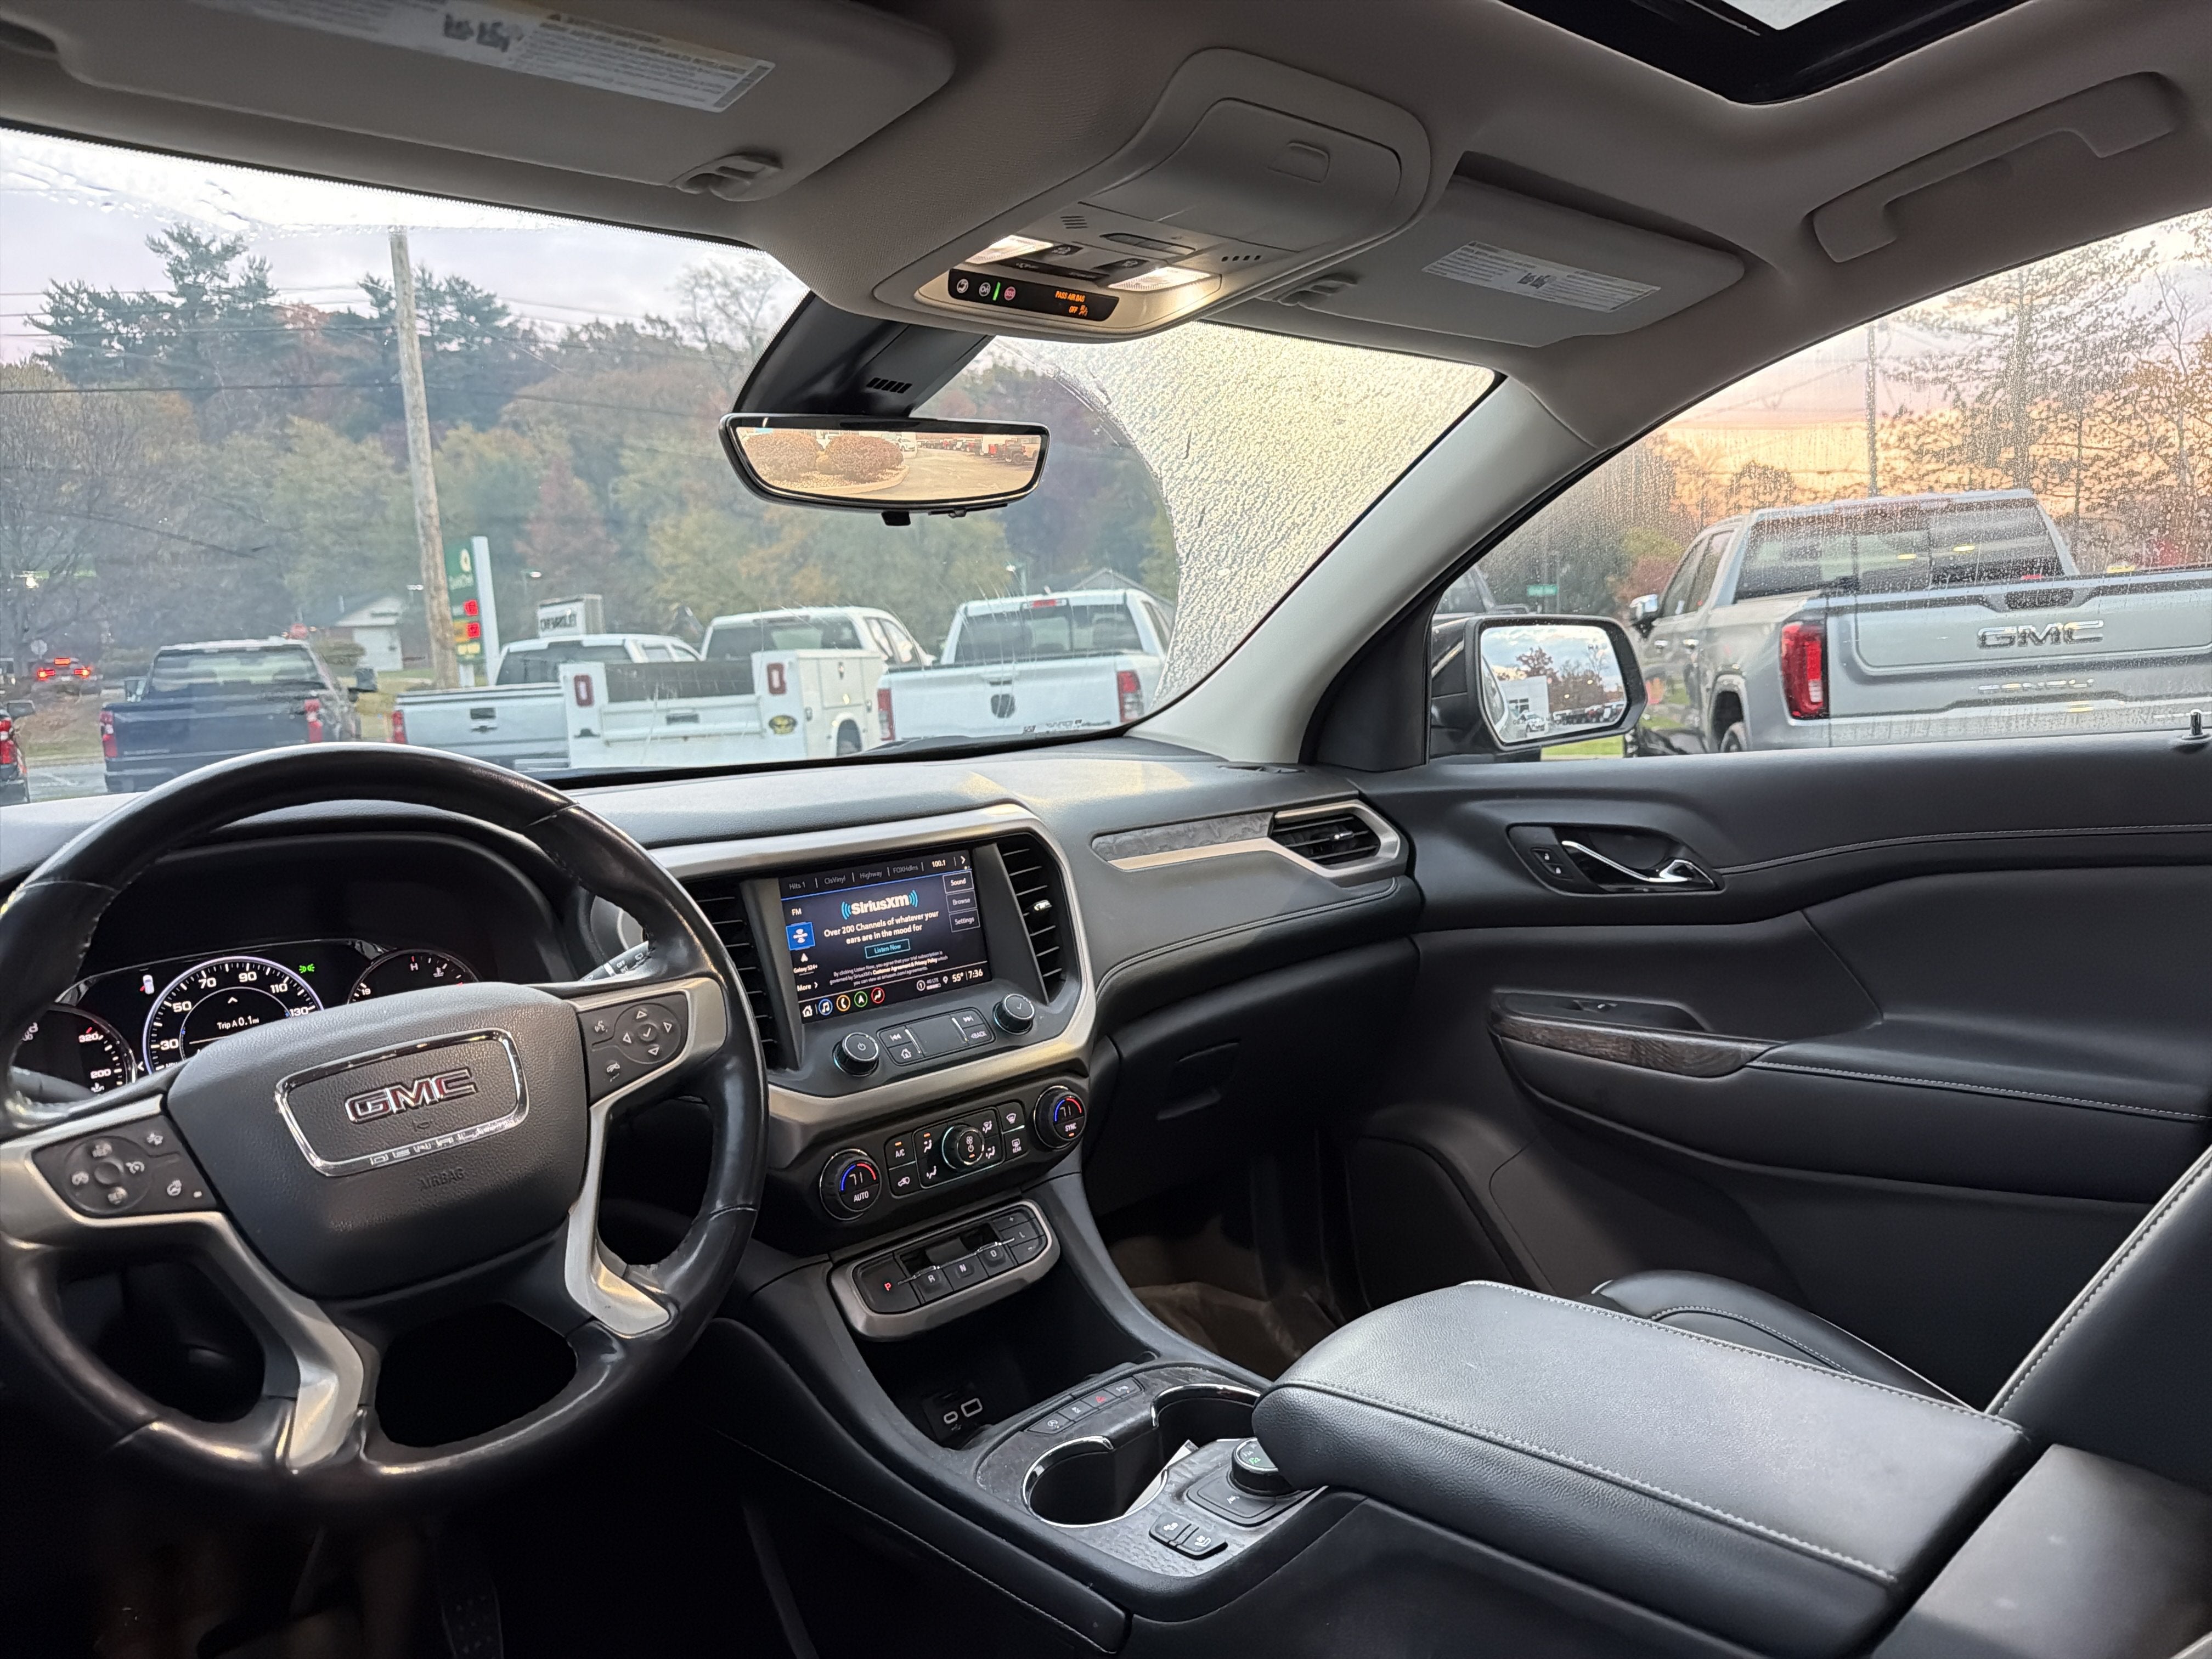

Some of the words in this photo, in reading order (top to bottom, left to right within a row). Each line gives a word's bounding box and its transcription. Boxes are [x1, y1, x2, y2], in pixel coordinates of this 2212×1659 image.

[1055, 290, 1068, 300] PASS
[1067, 293, 1076, 301] AIR
[1075, 294, 1086, 303] BAG
[1977, 620, 2104, 650] GMC
[824, 875, 846, 884] ClsVinyl
[860, 871, 882, 880] Highway
[950, 878, 966, 886] Sound
[952, 898, 970, 906] Browse
[824, 929, 840, 937] Over
[842, 926, 855, 934] 200
[856, 919, 887, 931] Channels
[887, 917, 894, 926] of
[895, 913, 924, 924] whatever
[924, 911, 939, 921] your
[955, 916, 975, 926] Settings
[882, 929, 892, 938] the
[893, 925, 912, 934] mood
[912, 923, 922, 932] for
[874, 946, 889, 954] Listen
[410, 963, 419, 971] H
[239, 972, 257, 983] 90
[968, 968, 983, 979] 7:36
[198, 977, 217, 989] 70
[270, 983, 288, 994] 110
[797, 984, 811, 992] More
[173, 1001, 192, 1013] 50
[289, 1006, 309, 1017] 130
[78, 1032, 99, 1043] 320
[160, 1039, 179, 1051] 30
[91, 1068, 111, 1079] 200
[344, 1066, 478, 1125] GMC
[1065, 1122, 1077, 1132] SYNC
[895, 1149, 905, 1158] A/C
[419, 1166, 466, 1191] AIRBAG
[853, 1191, 870, 1203] AUTO
[959, 1263, 967, 1272] N
[928, 1274, 936, 1283] R
[884, 1282, 892, 1291] P
